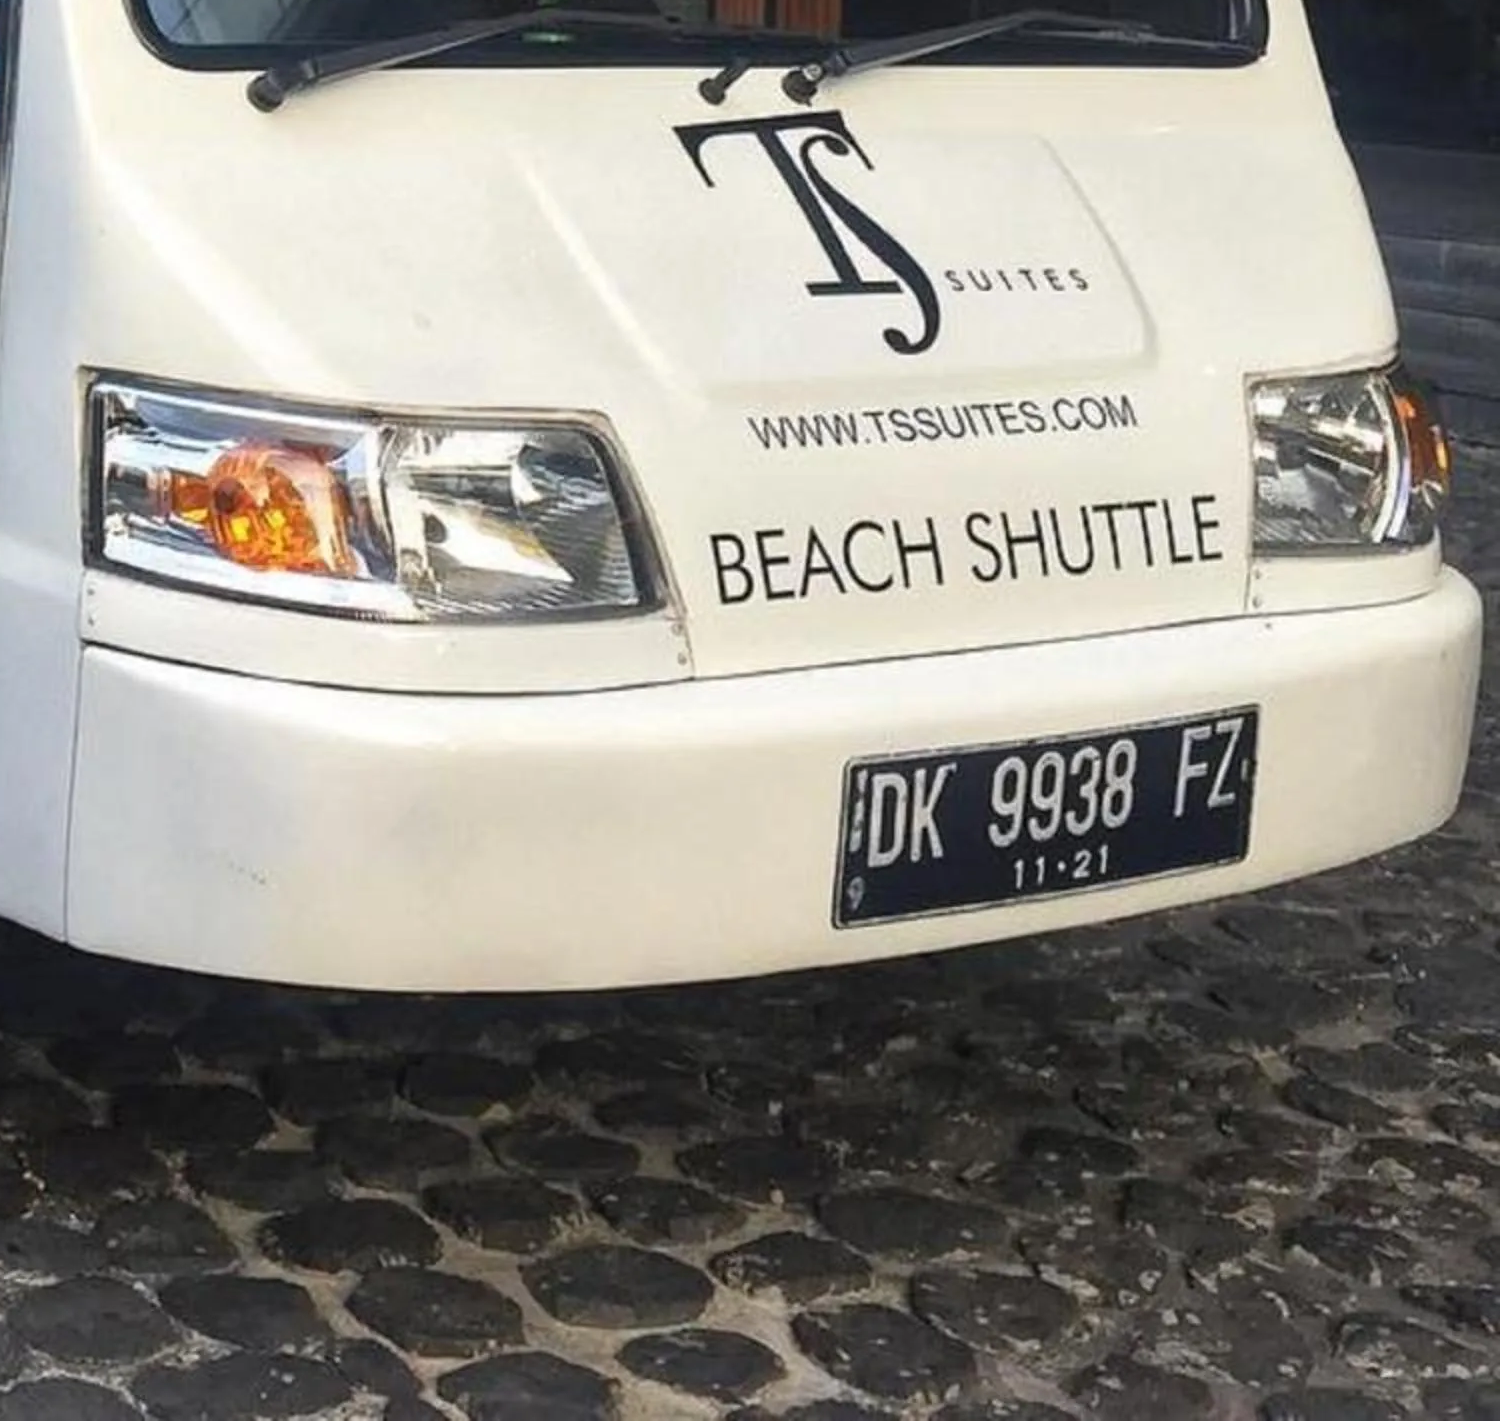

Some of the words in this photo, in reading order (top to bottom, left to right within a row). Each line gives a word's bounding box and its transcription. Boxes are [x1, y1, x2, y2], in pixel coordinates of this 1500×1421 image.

[943, 267, 1091, 293] SUITES
[747, 394, 1140, 450] WWW.TSSUITES.COM
[709, 516, 945, 606] BEACH
[964, 494, 1224, 584] SHUTTLE
[867, 763, 957, 868] DK
[987, 738, 1138, 848] 9938
[1173, 717, 1245, 819] FZ
